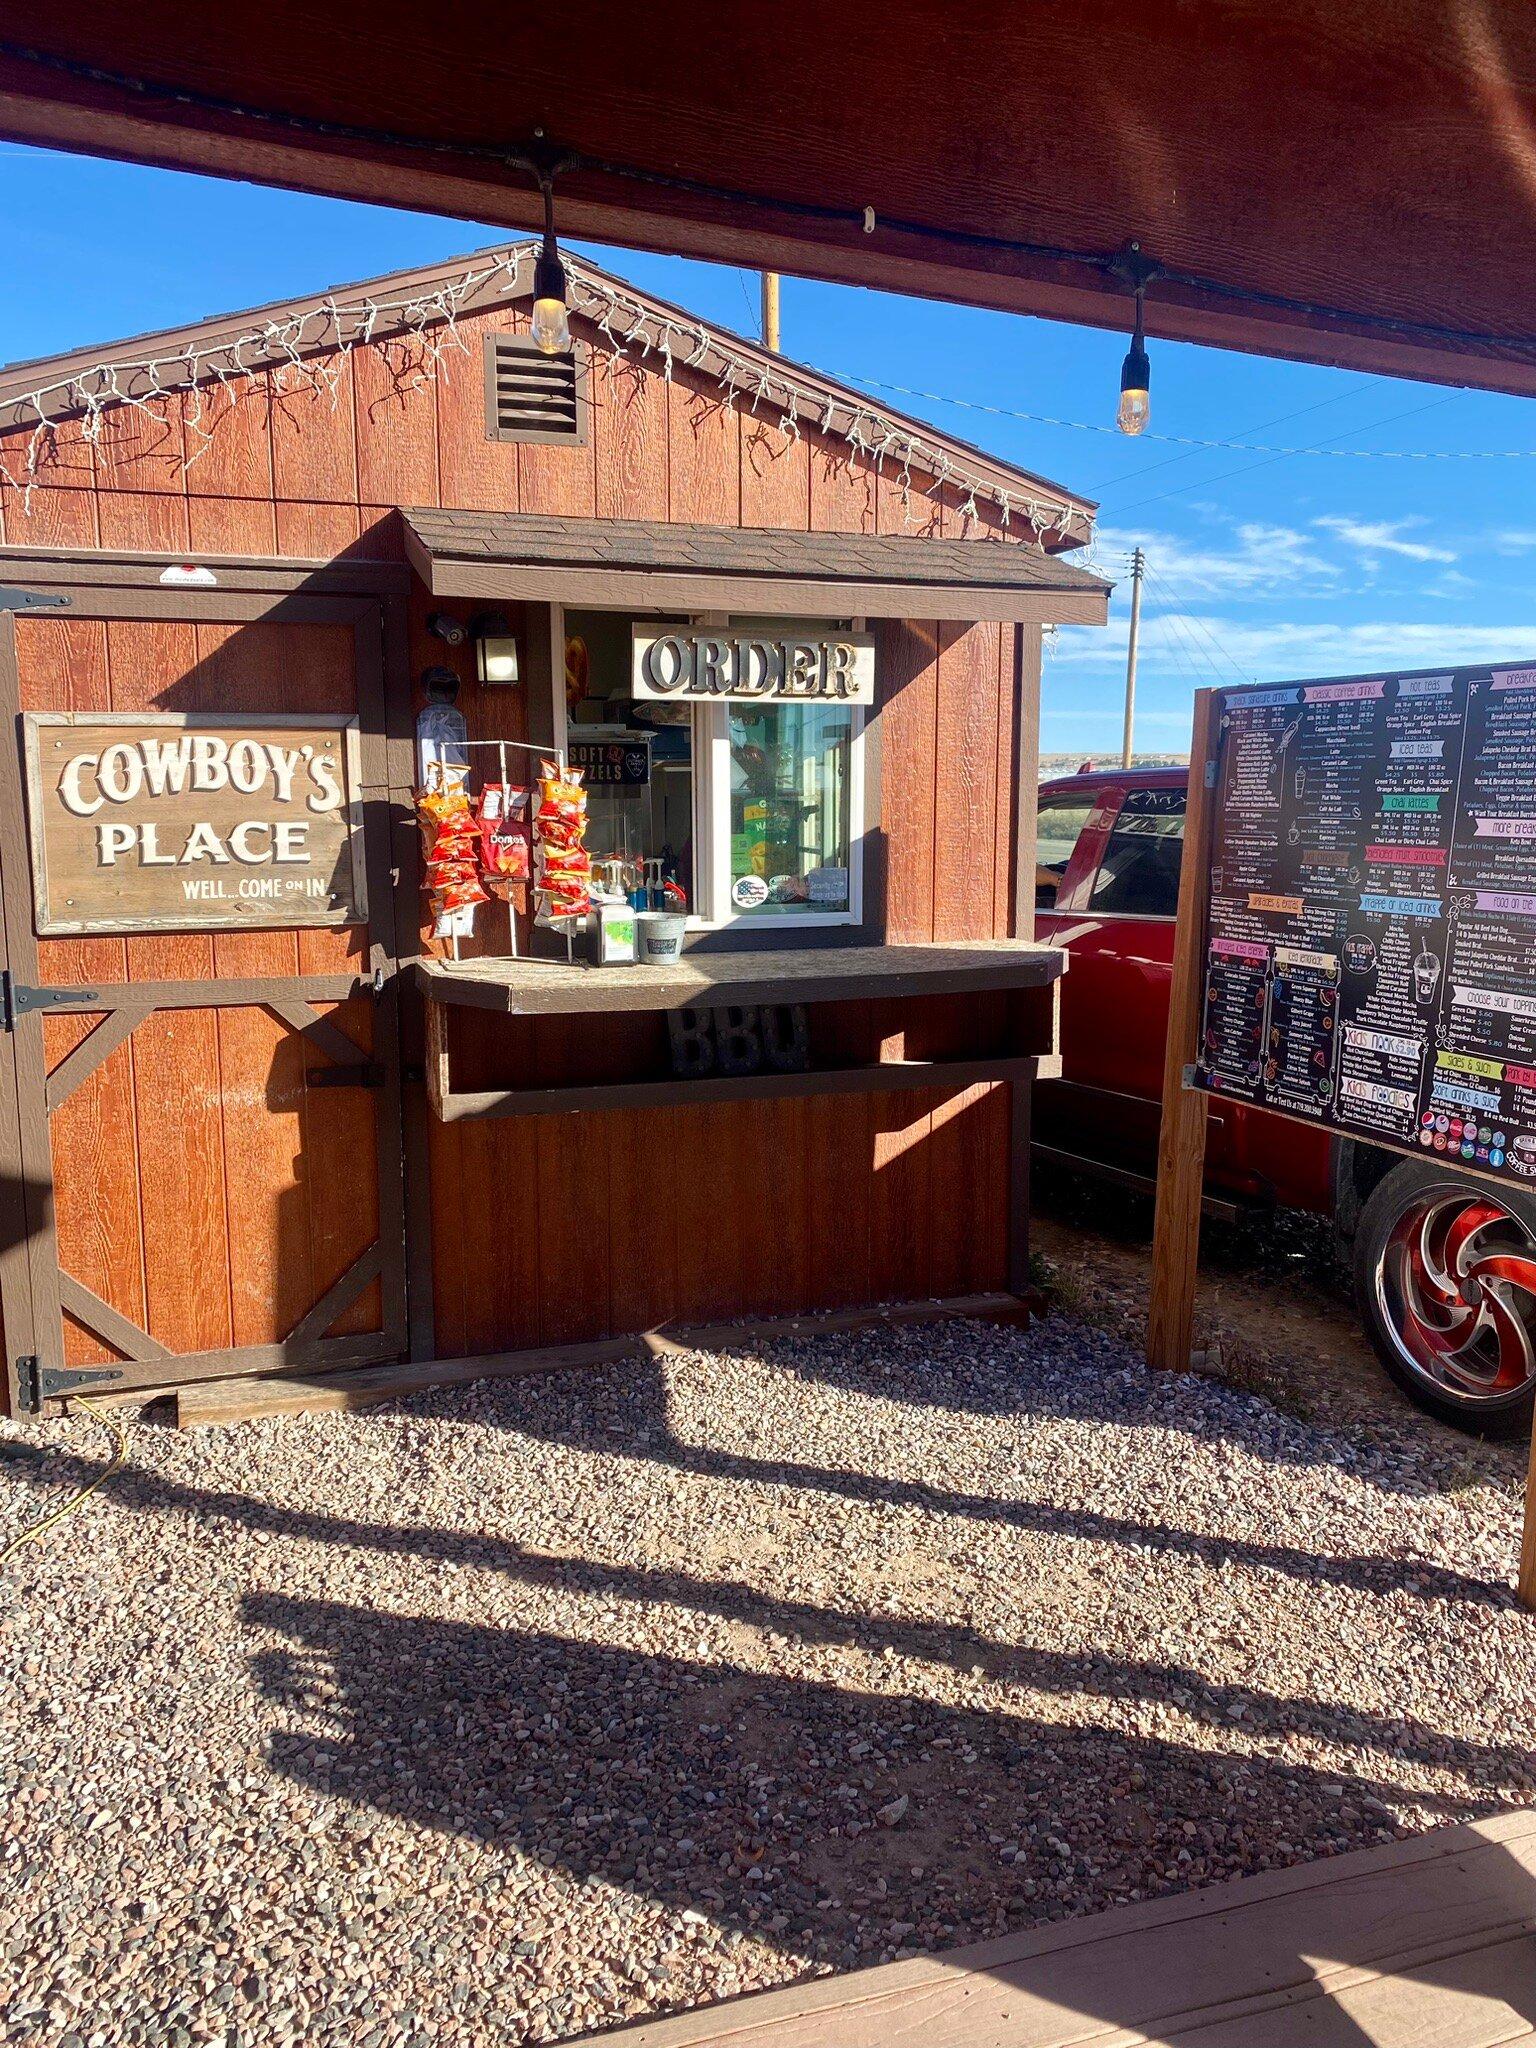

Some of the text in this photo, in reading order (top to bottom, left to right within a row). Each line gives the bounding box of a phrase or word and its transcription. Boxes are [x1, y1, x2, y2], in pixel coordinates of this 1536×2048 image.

[641, 635, 859, 700] ORDER
[569, 747, 603, 762] SOFT
[56, 736, 341, 817] COWBOY'S
[95, 821, 312, 868] PLACE
[490, 834, 525, 845] Doritos
[286, 880, 304, 890] ON
[306, 878, 325, 897] IN
[1395, 1045, 1416, 1056] $2.90
[1508, 1042, 1533, 1053] Hot Sauce
[1506, 1151, 1528, 1174] COFFEE
